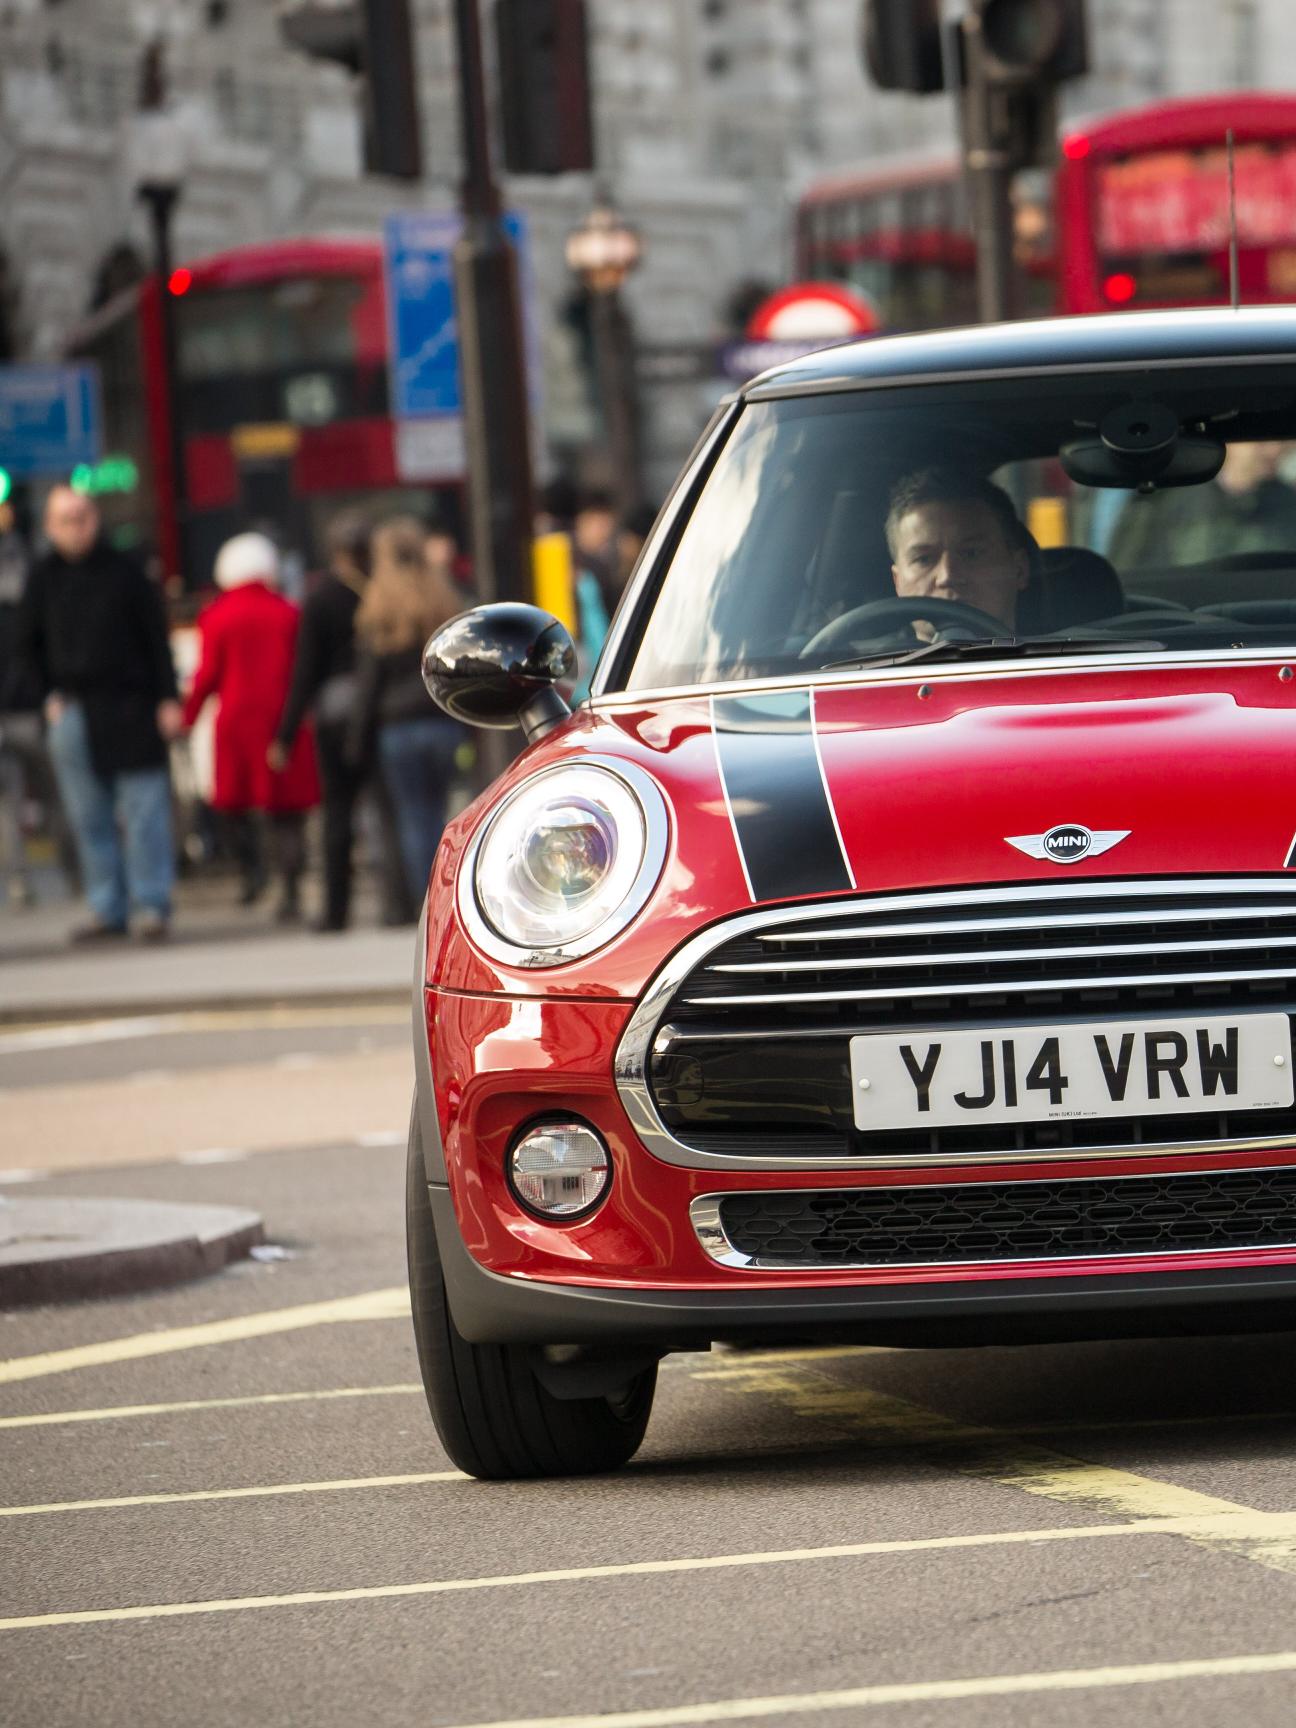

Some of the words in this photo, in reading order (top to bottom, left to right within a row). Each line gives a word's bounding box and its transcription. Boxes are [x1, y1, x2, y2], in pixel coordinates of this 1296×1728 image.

[1048, 835, 1087, 848] MINI
[899, 1037, 1068, 1112] YJ14
[1093, 1027, 1238, 1102] VRW
